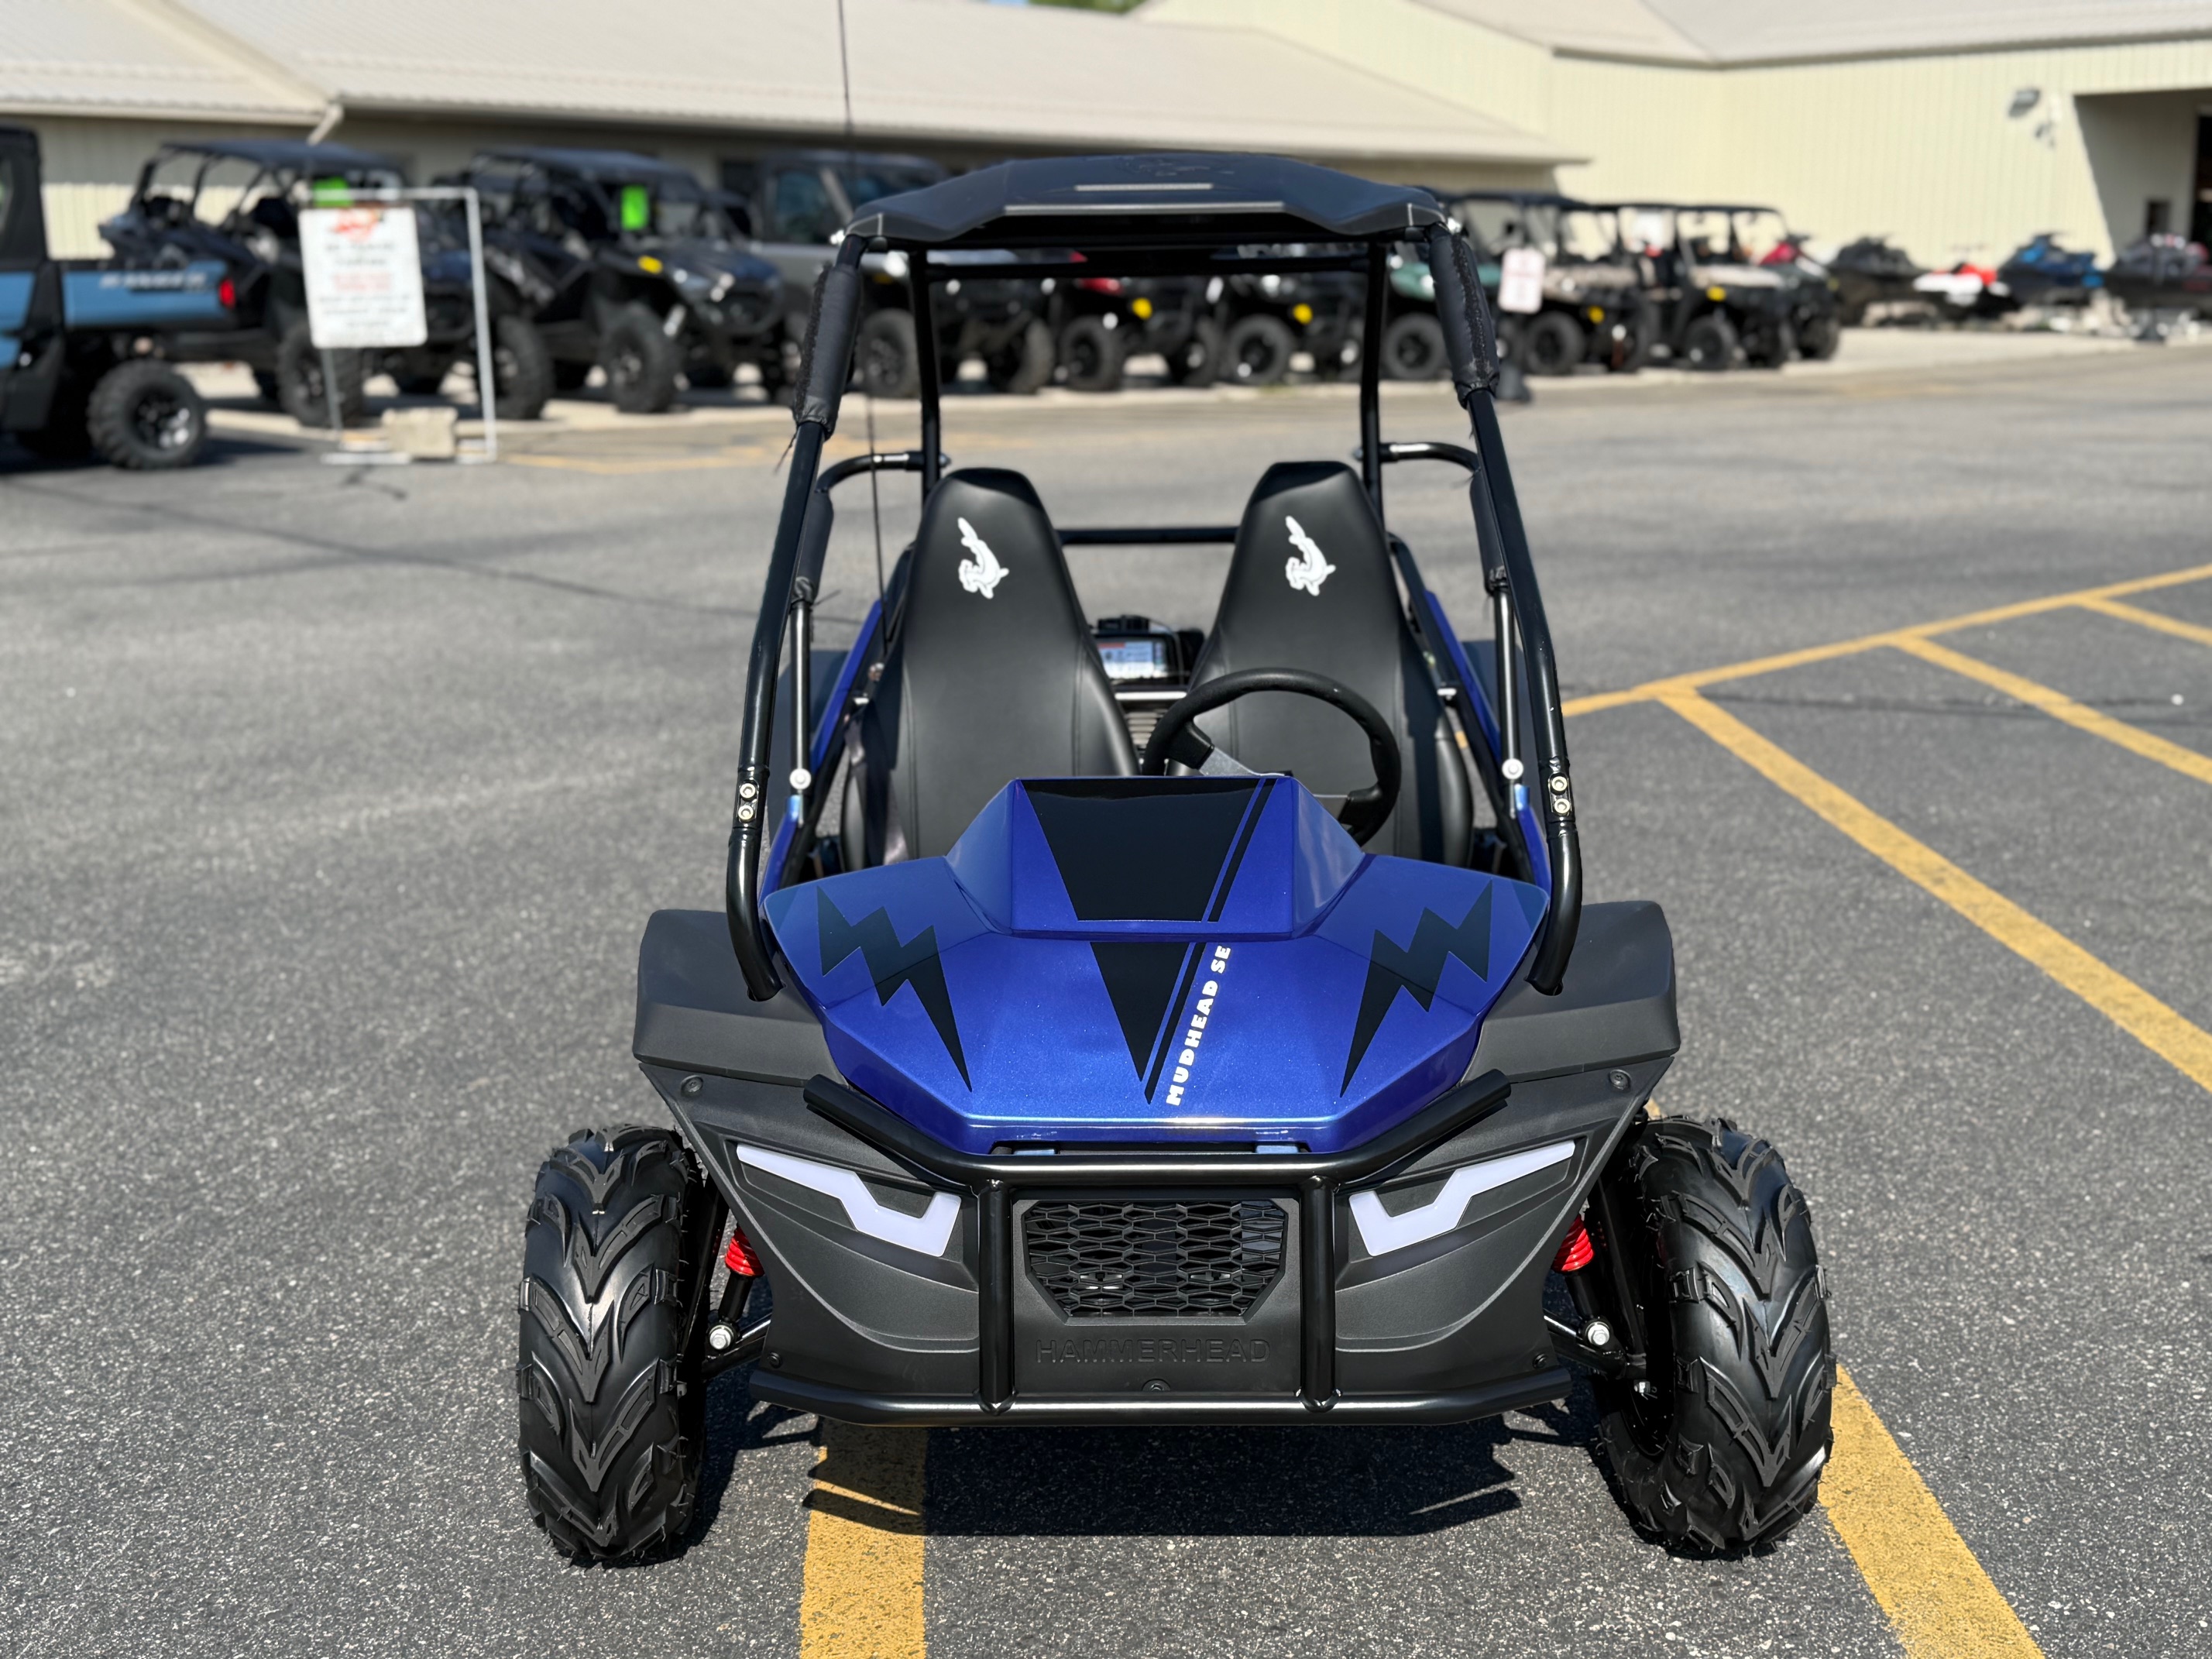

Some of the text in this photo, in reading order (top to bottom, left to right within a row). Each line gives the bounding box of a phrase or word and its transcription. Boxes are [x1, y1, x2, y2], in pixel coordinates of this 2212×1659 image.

[1166, 945, 1231, 1106] MUDHEAD SE
[1036, 1338, 1271, 1363] HAMMERHEAD
